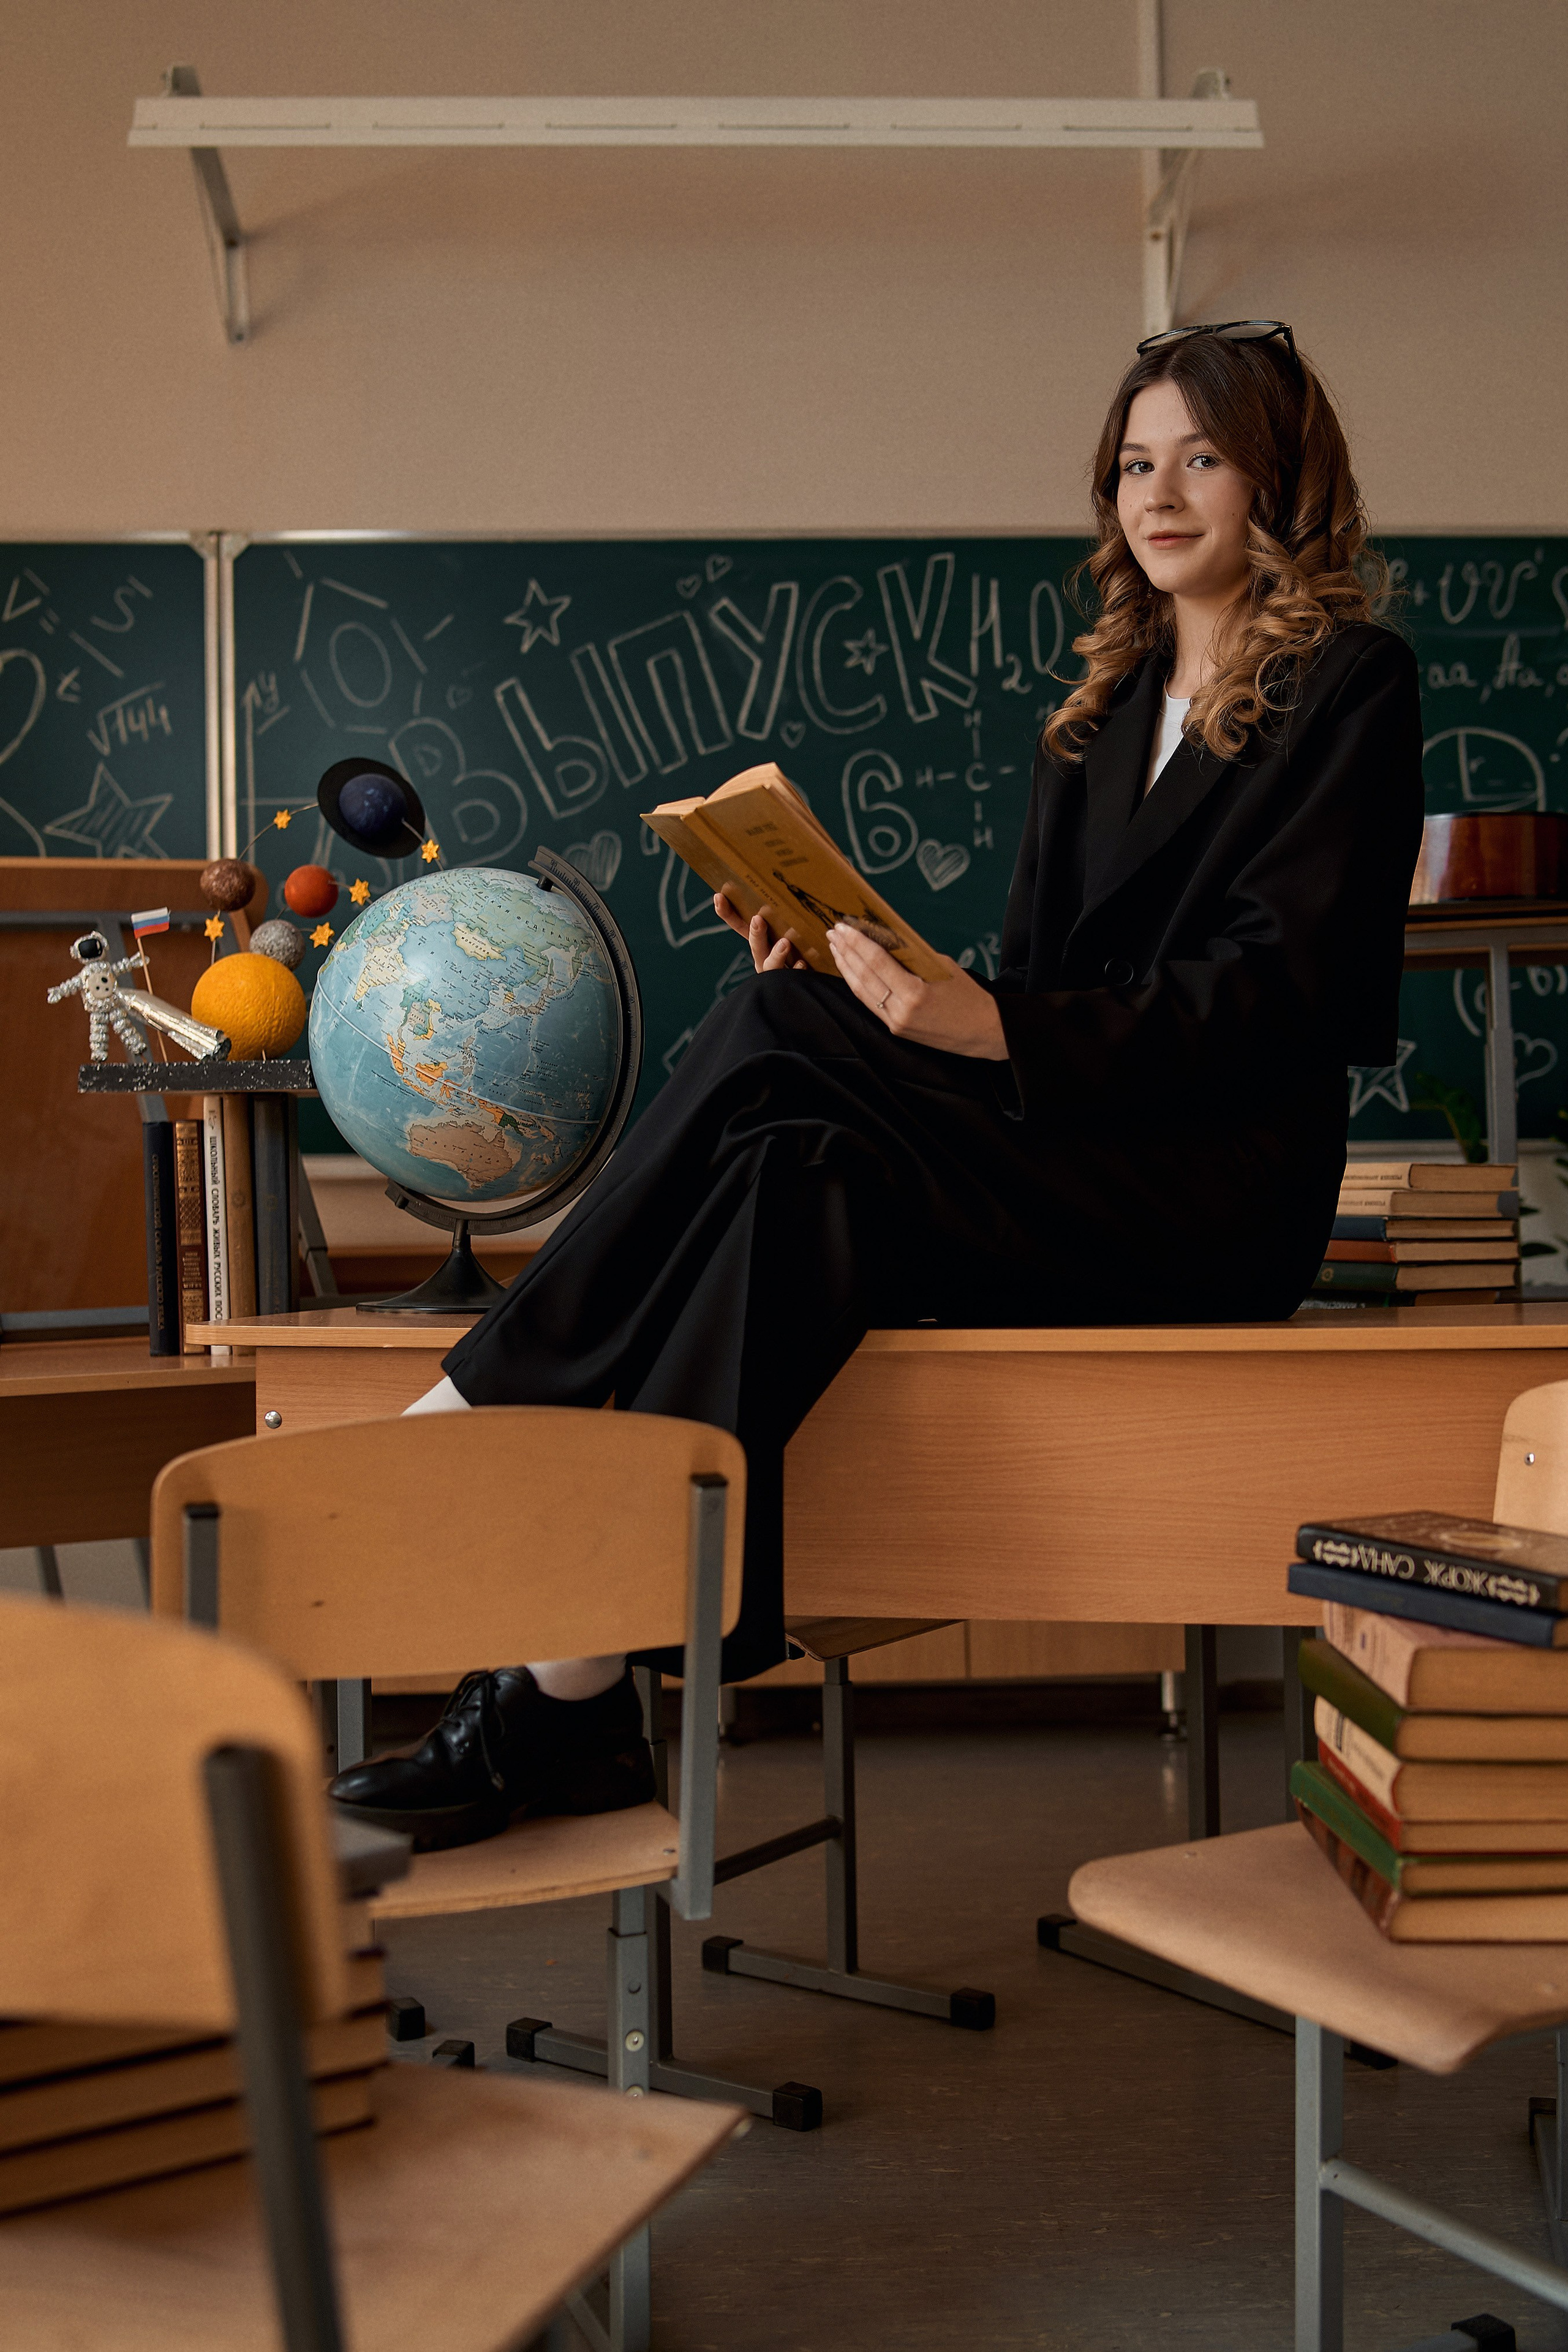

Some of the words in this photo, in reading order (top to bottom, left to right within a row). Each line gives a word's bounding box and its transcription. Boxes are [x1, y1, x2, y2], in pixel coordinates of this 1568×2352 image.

[461, 936, 490, 956] МОНГОЛИЯ
[1357, 1544, 1415, 1580] САНД
[1423, 1558, 1490, 1597] ЖОРЖ
